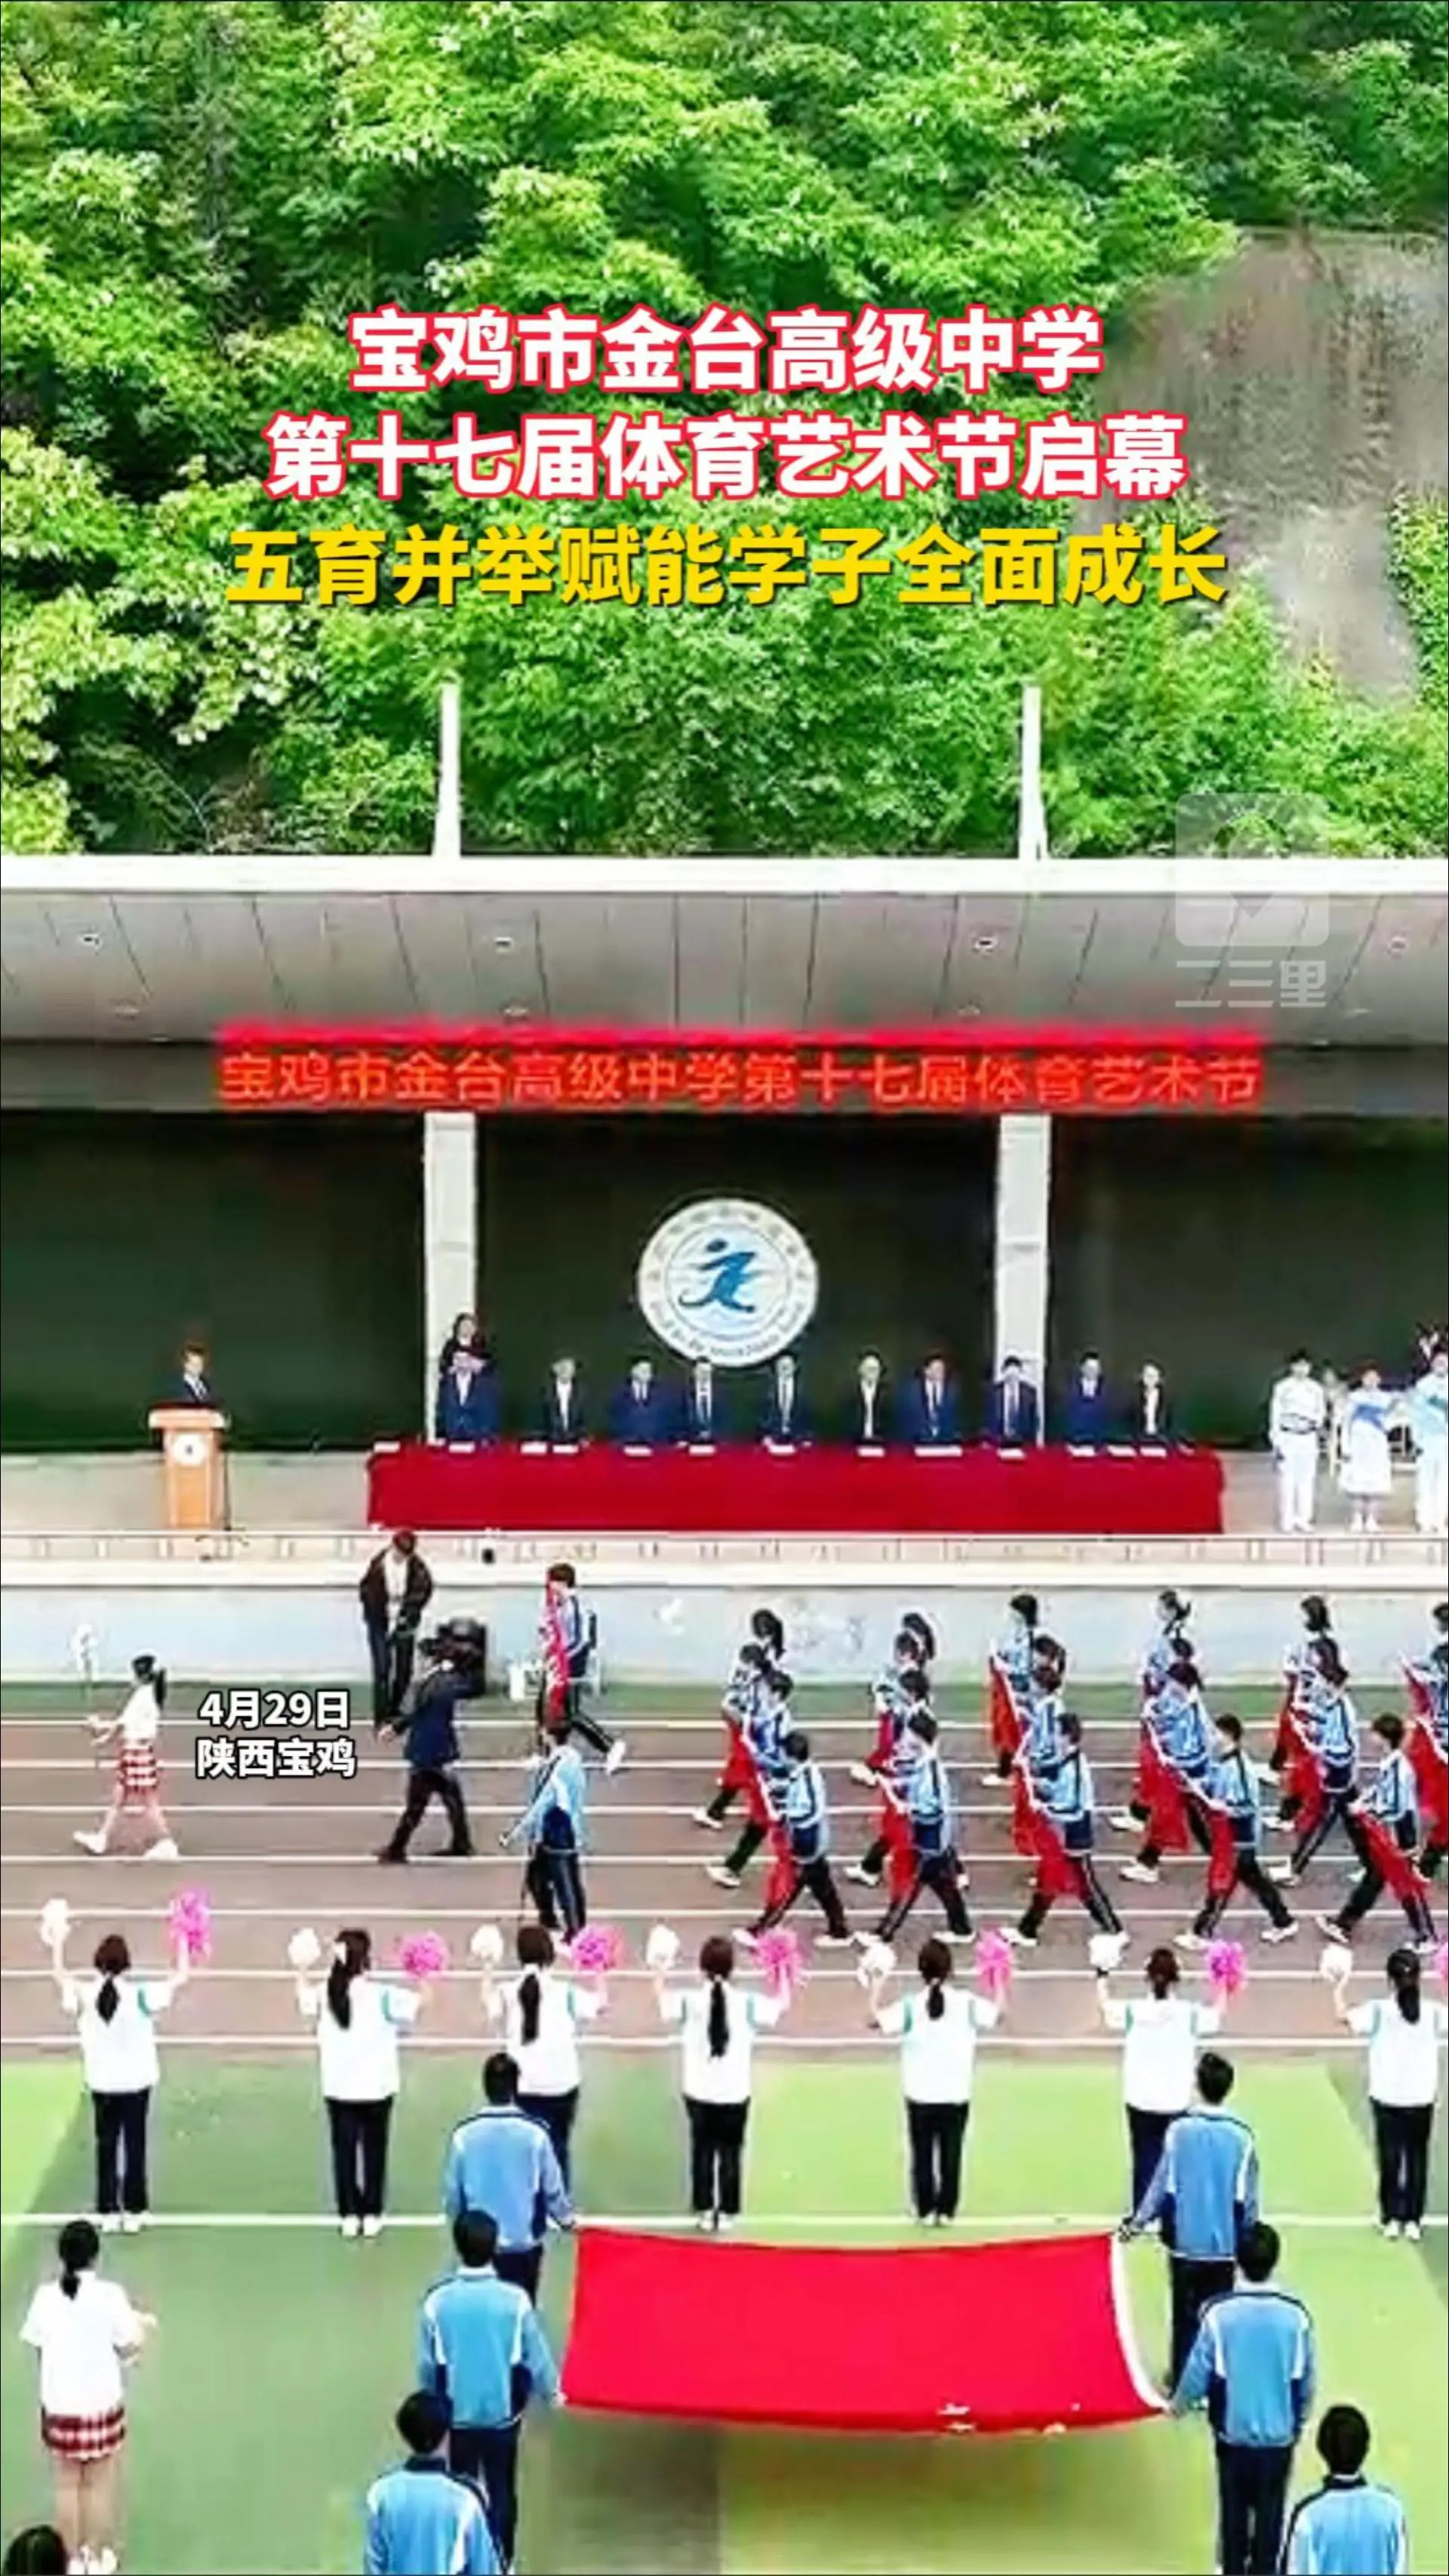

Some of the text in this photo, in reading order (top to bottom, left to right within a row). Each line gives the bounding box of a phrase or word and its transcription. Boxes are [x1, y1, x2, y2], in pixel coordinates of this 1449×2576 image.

[219, 1052, 1262, 1106] 宝鸡市金台高级中学第十七届体育艺术节
